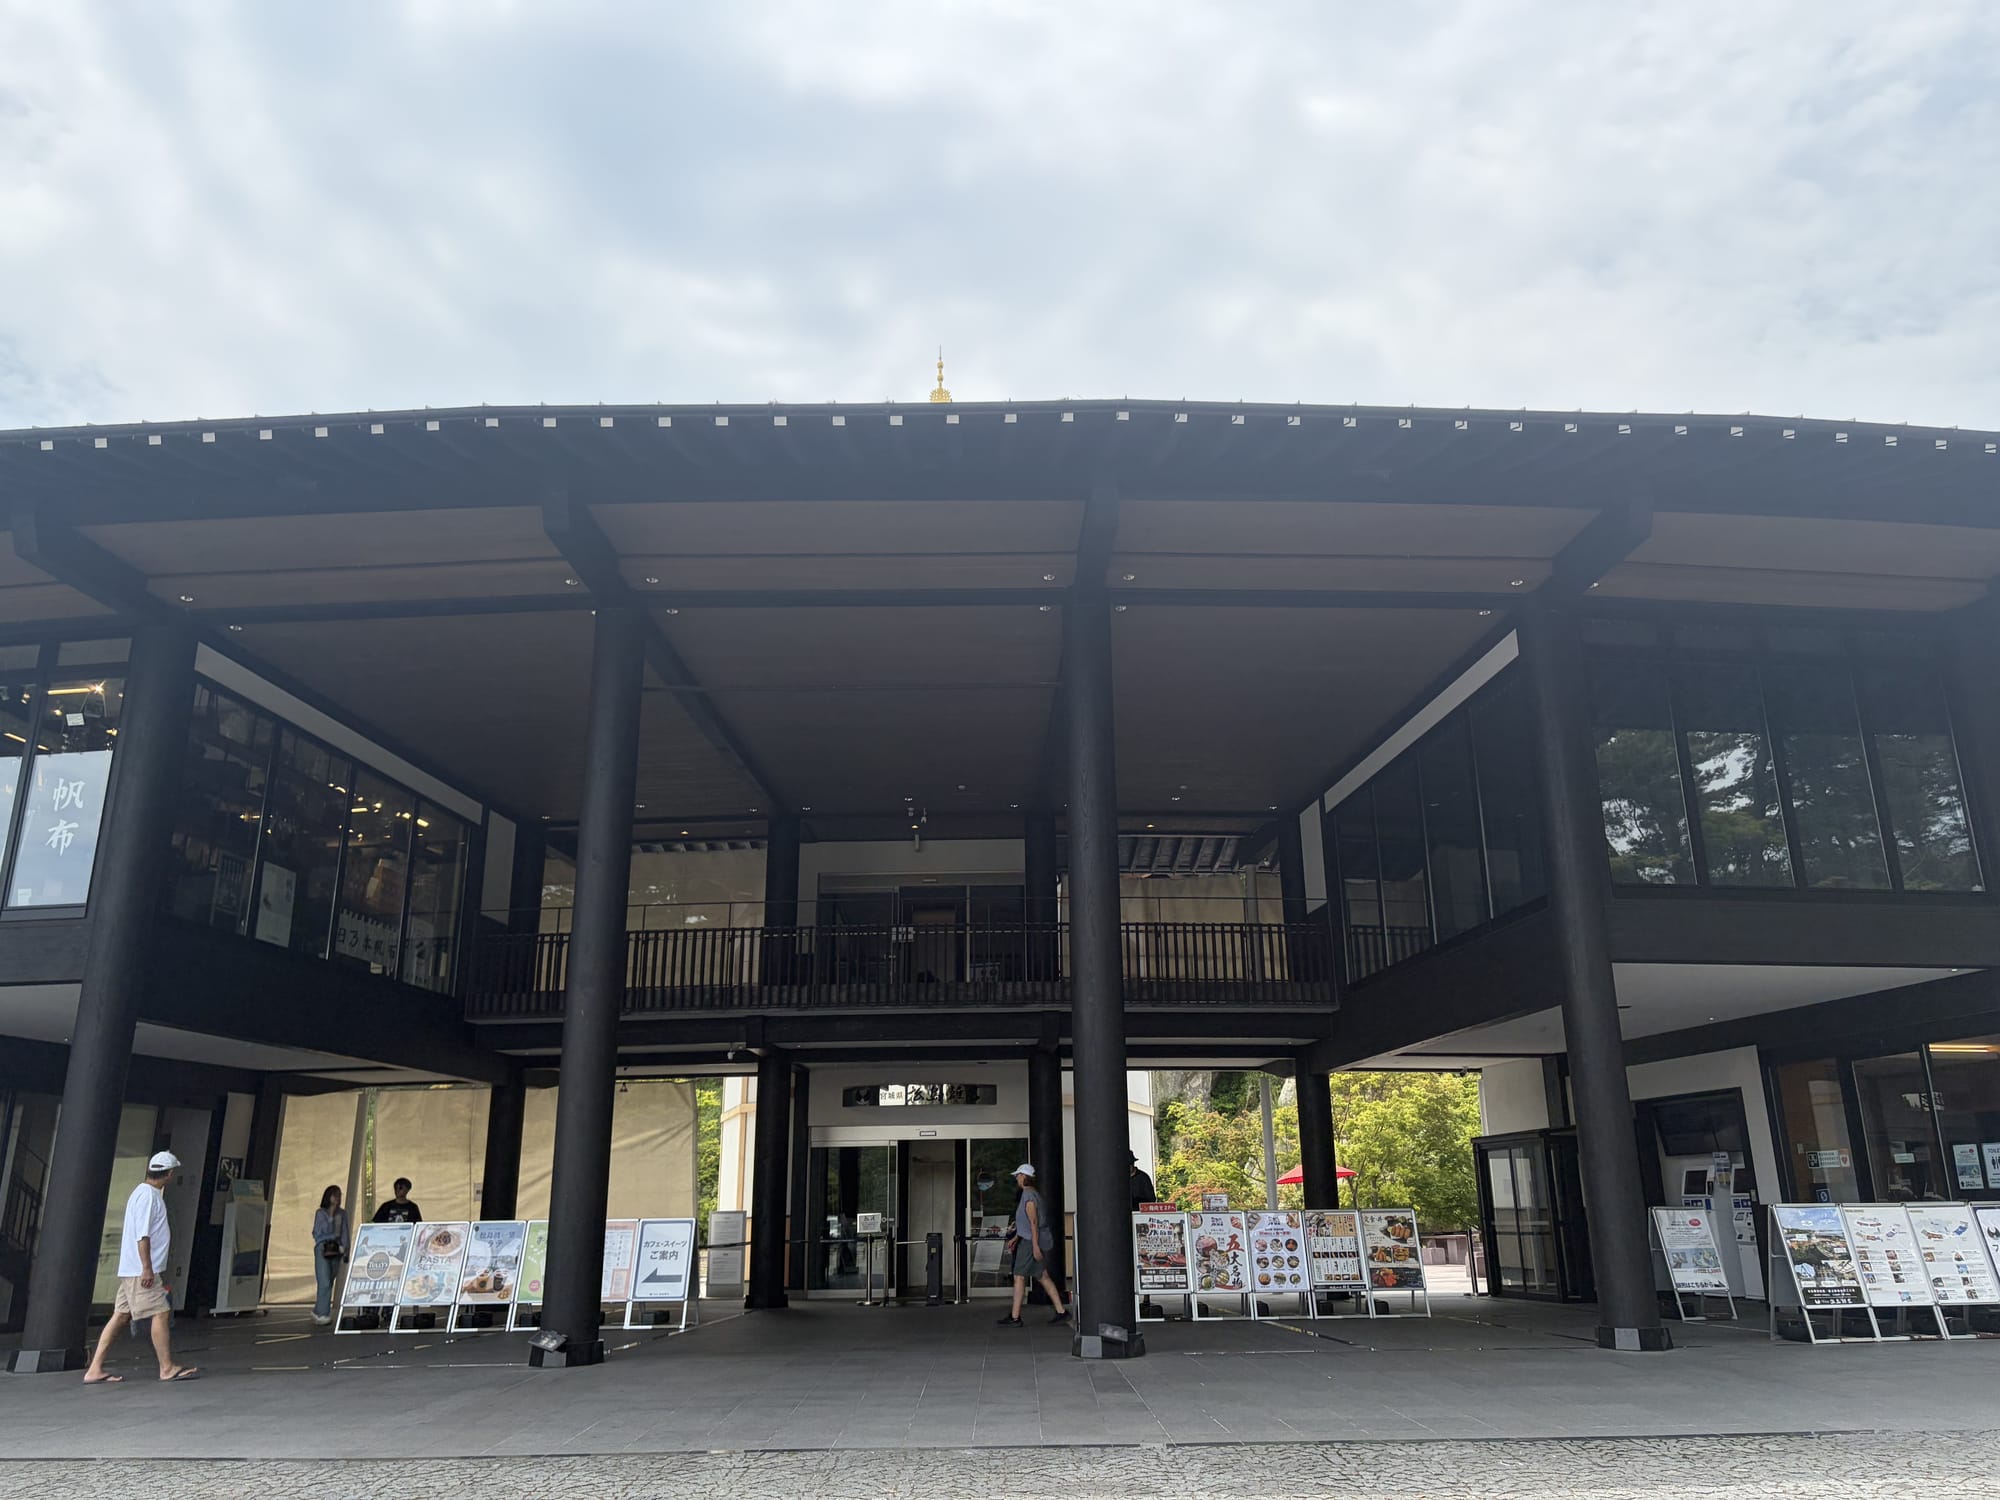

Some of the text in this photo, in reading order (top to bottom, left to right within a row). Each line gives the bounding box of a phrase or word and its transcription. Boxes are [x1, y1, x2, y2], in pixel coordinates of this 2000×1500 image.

[45, 778, 86, 856] 帆布
[643, 1240, 688, 1249] カフェ・スイーツ
[419, 1255, 451, 1264] PASTA
[650, 1250, 679, 1261] ご案内
